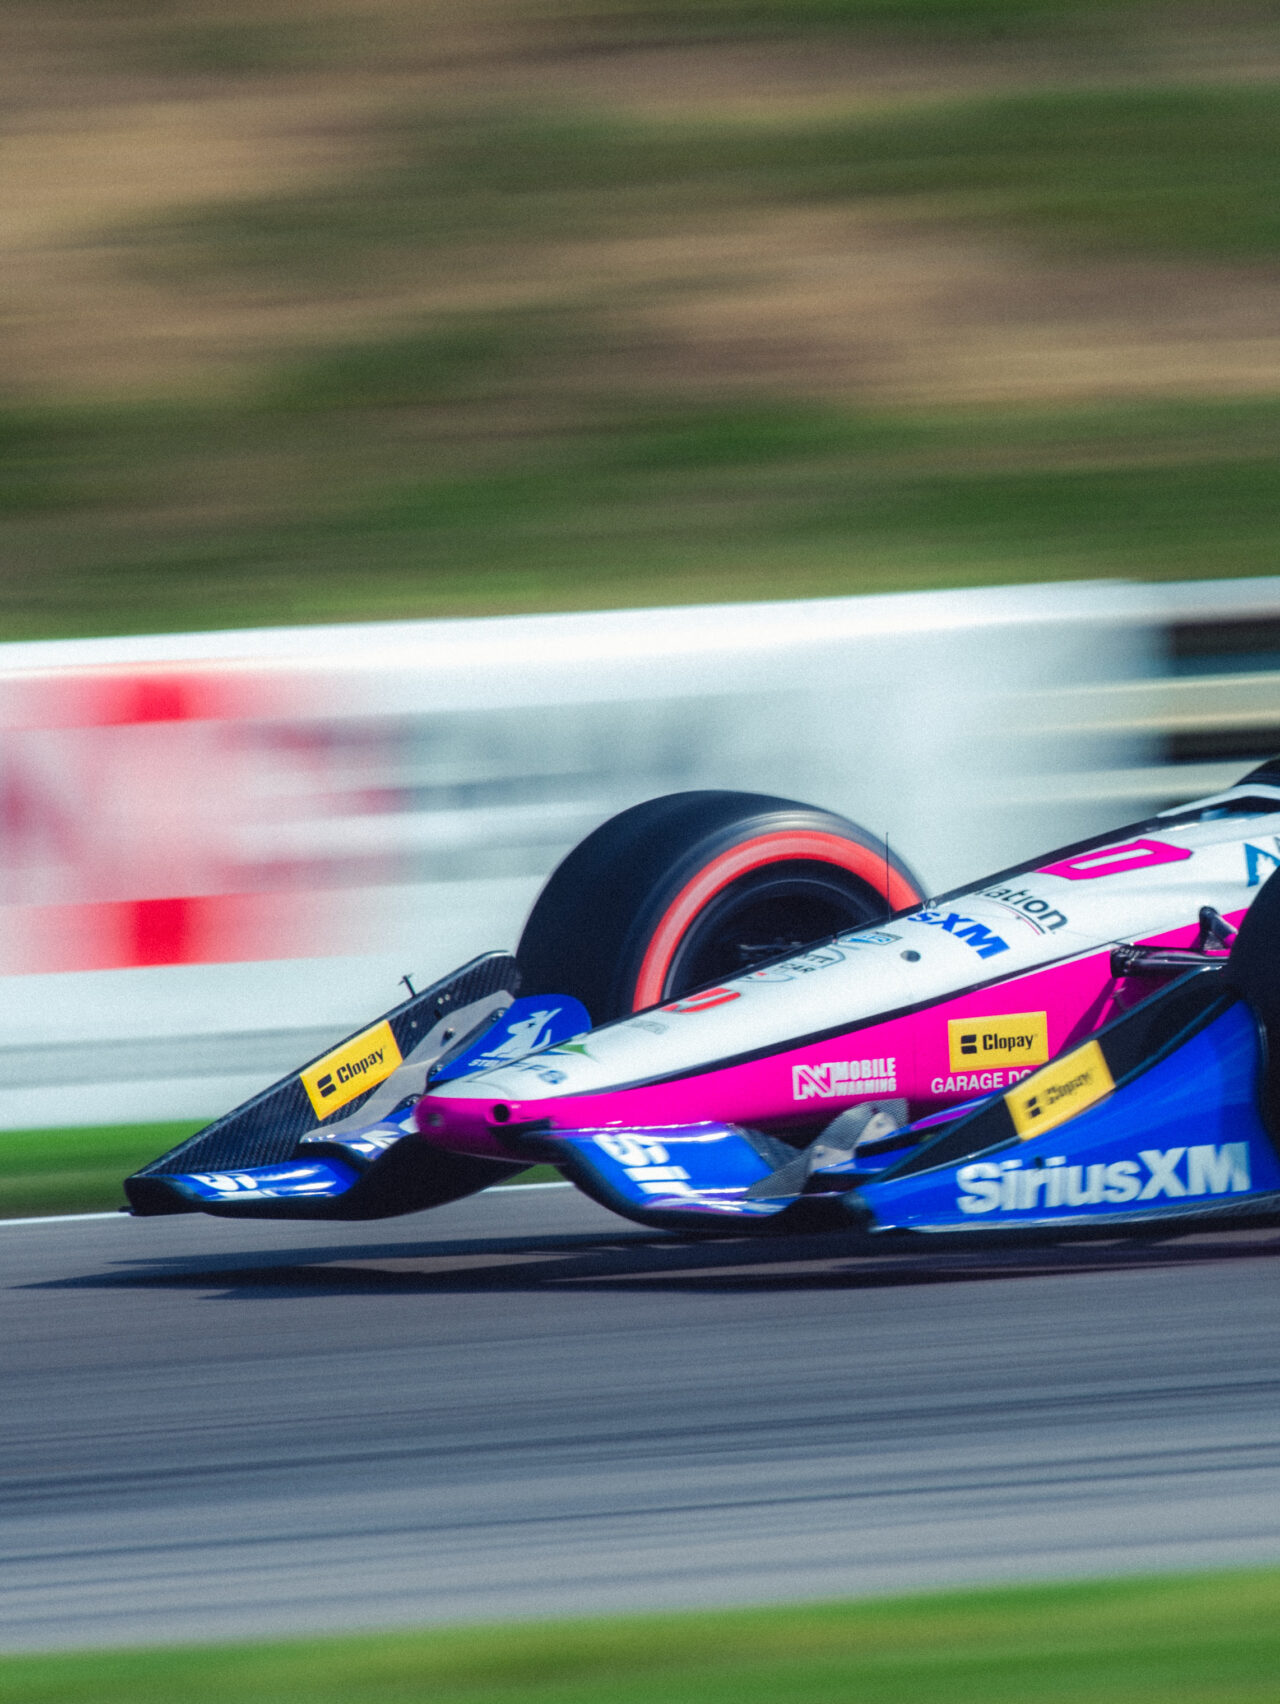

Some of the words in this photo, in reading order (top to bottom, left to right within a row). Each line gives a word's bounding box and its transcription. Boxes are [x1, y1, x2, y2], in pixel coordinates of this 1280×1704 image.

[974, 885, 1068, 930] ation
[983, 1032, 1033, 1051] Clopay
[336, 1048, 384, 1084] Clopay
[832, 1057, 896, 1081] MOBILE
[931, 1072, 1003, 1094] GARAGE
[956, 1142, 1251, 1215] SiriusXM
